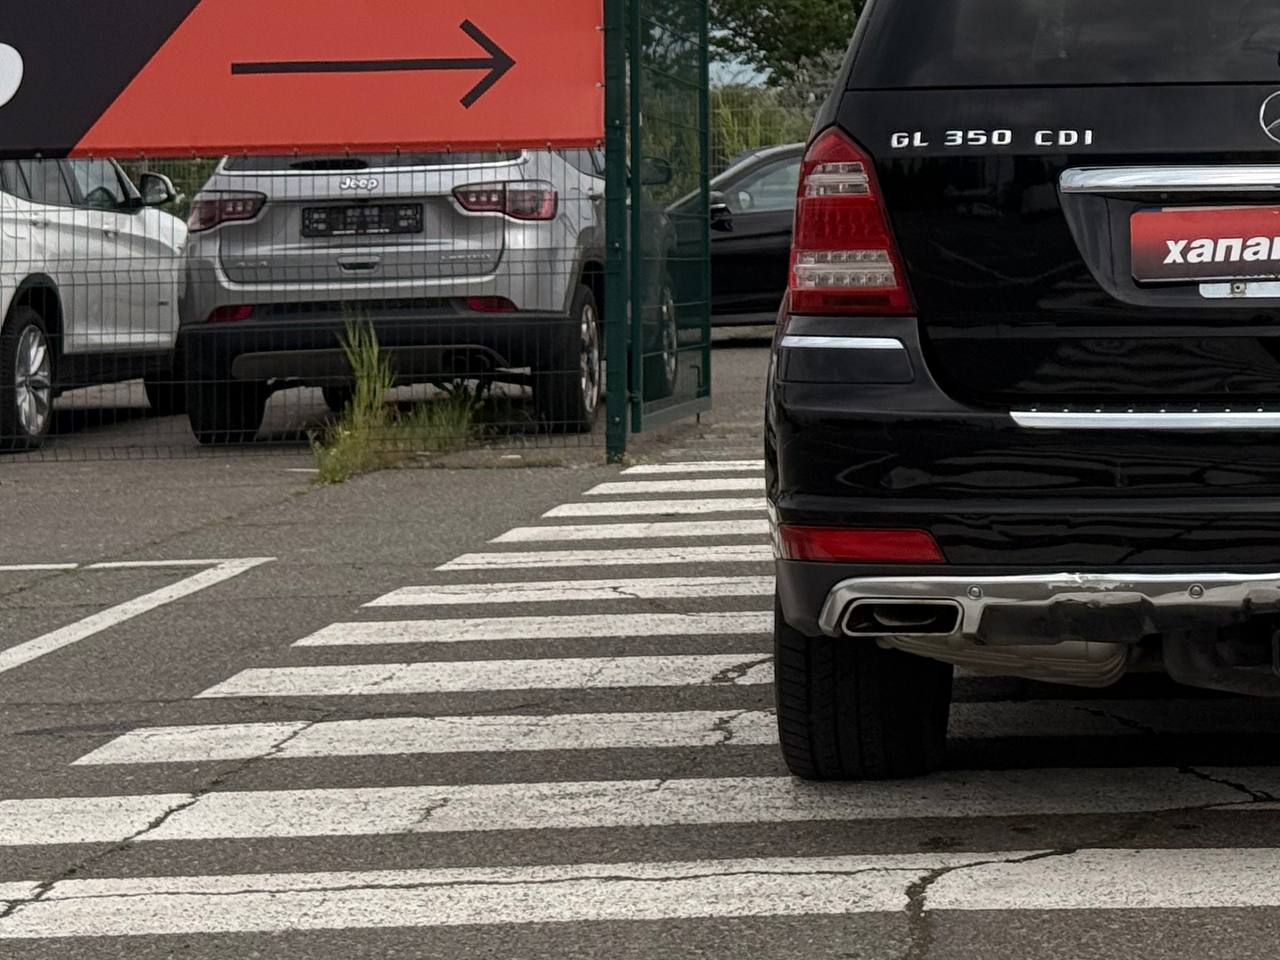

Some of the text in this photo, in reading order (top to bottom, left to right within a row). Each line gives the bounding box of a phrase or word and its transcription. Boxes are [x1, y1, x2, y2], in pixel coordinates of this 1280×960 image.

[890, 129, 1093, 148] GL 350 CDI
[340, 177, 378, 190] Jeep
